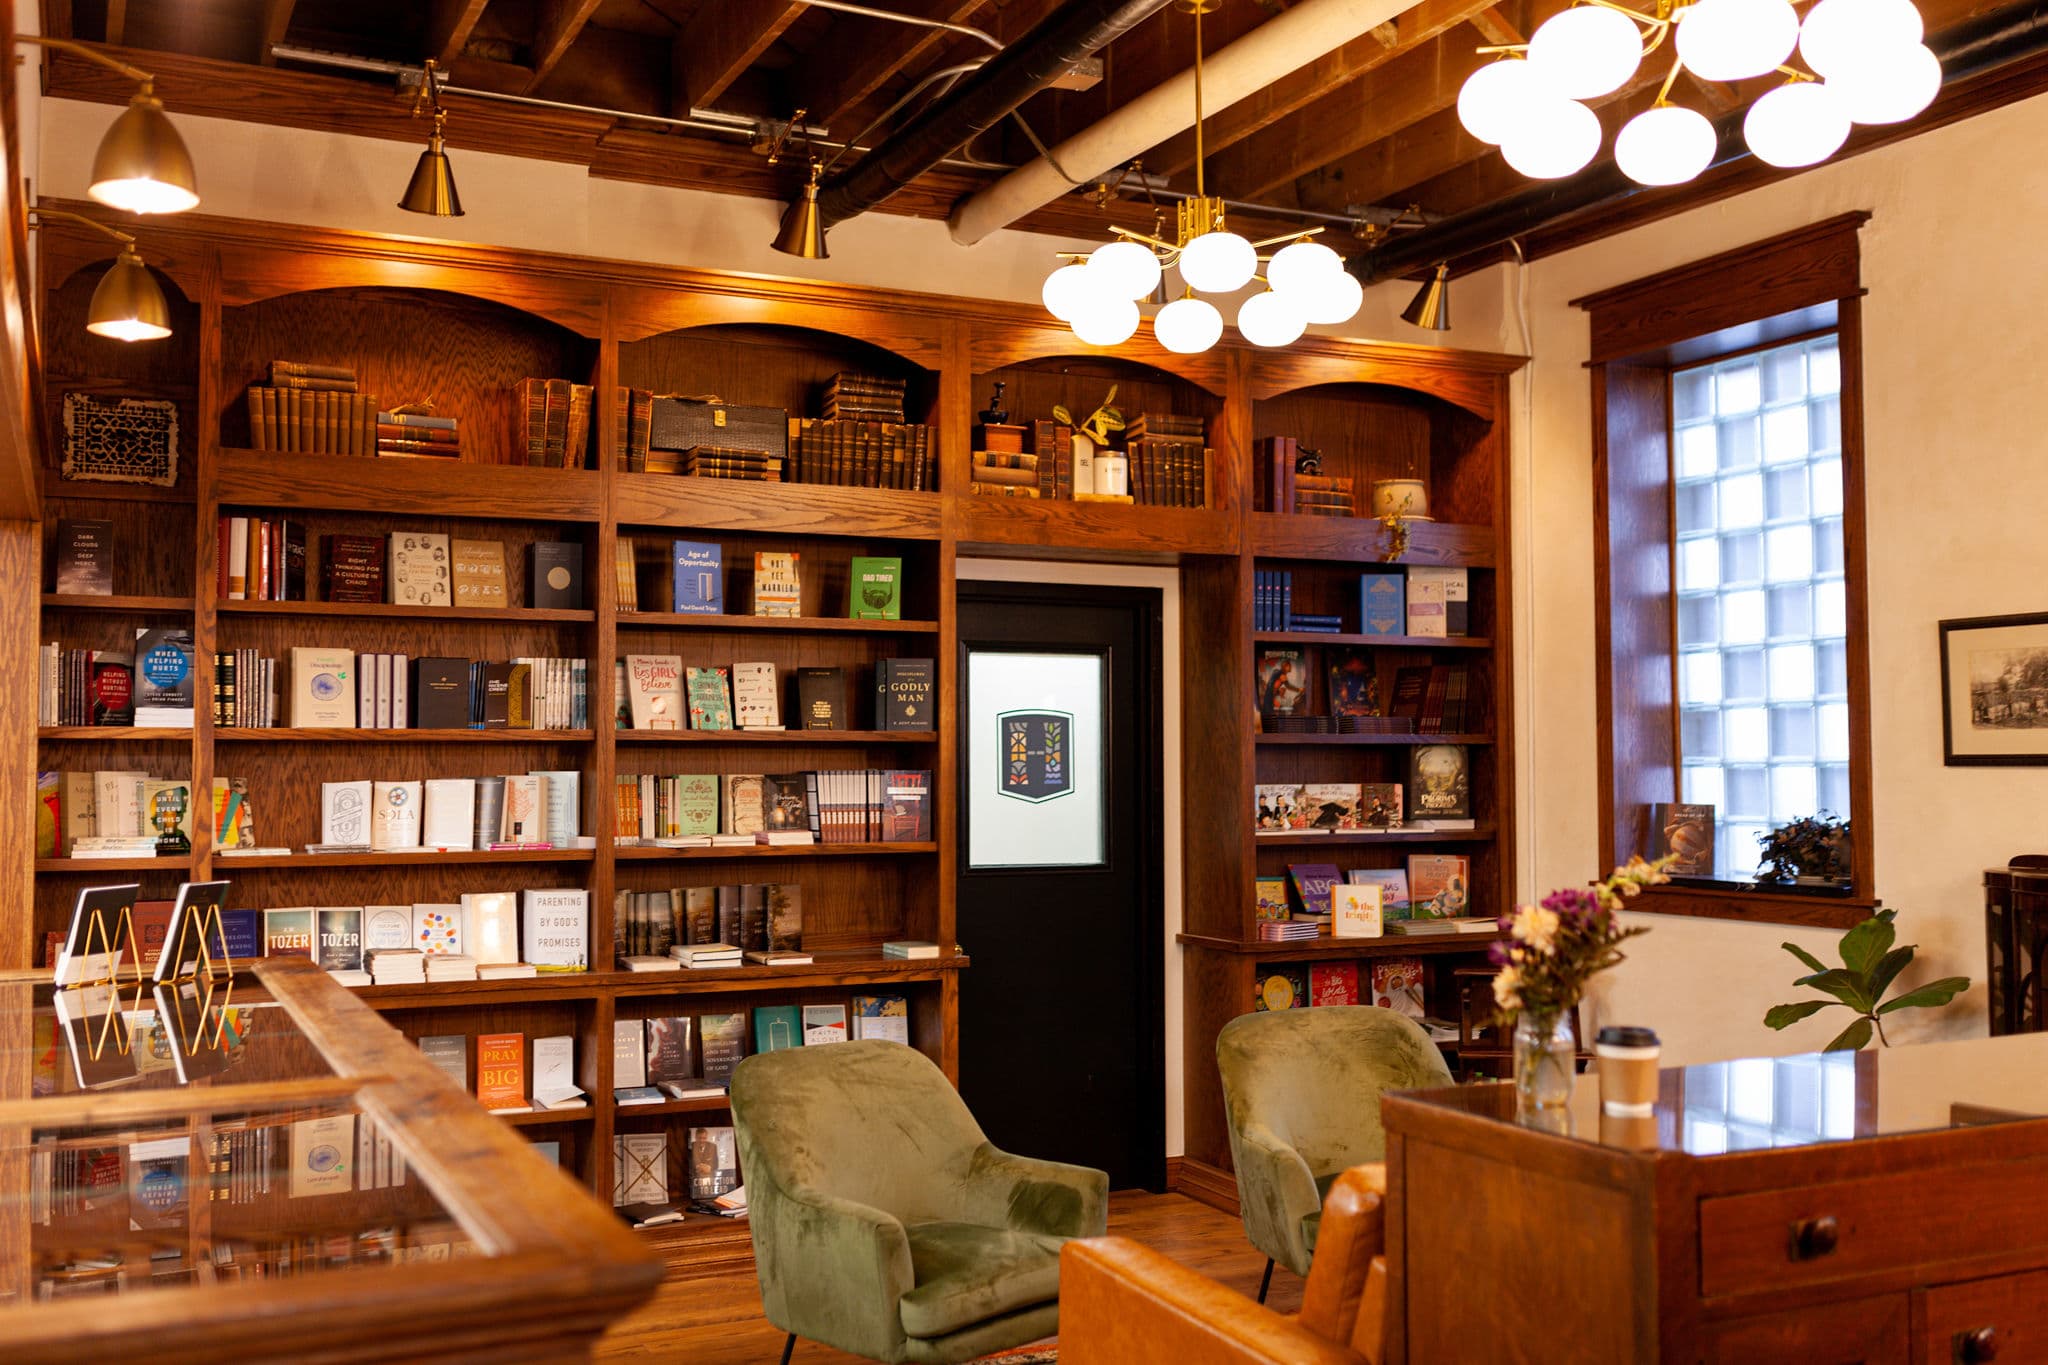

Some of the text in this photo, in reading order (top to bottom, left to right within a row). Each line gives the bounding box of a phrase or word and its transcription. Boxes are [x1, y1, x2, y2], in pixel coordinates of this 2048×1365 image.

[688, 551, 698, 559] Age
[678, 557, 720, 568] Opportunity
[770, 559, 784, 568] NOT
[771, 571, 784, 580] YET
[875, 574, 893, 582] TIRED
[762, 583, 793, 592] MARRIED
[650, 666, 678, 679] GIRLS
[641, 676, 673, 692] Believe
[890, 682, 931, 692] GODLY
[897, 694, 924, 702] MAN
[537, 897, 582, 907] PARENTING
[1361, 902, 1375, 911] the
[540, 917, 578, 927] BY GOD'S
[270, 934, 309, 949] TOZER
[321, 933, 359, 947] TOZER
[538, 938, 581, 948] PROMISES
[483, 1050, 519, 1062] PRAY
[483, 1069, 519, 1086] BIG
